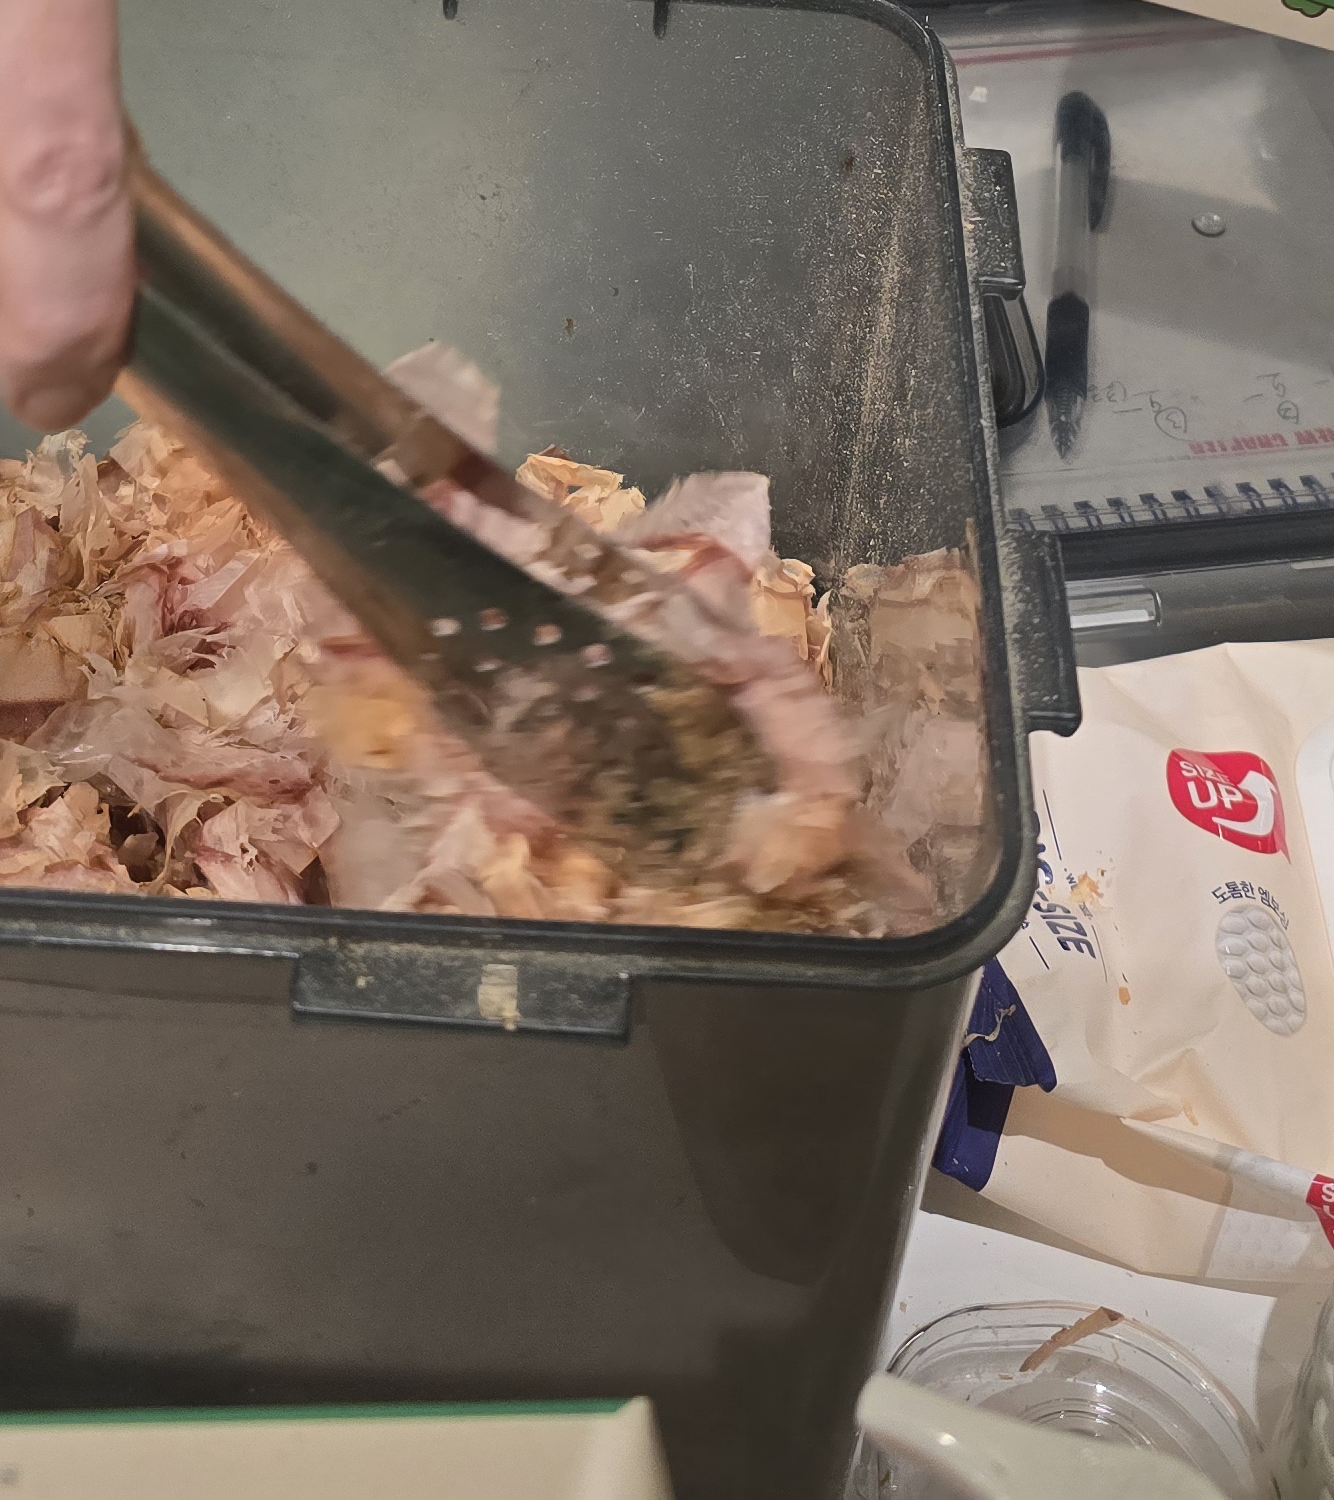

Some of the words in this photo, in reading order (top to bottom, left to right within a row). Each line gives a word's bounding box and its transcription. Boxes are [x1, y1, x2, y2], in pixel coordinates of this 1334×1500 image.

[1179, 760, 1230, 783] SIZE
[1187, 779, 1244, 810] UP
[1211, 880, 1256, 904] 도톰한
